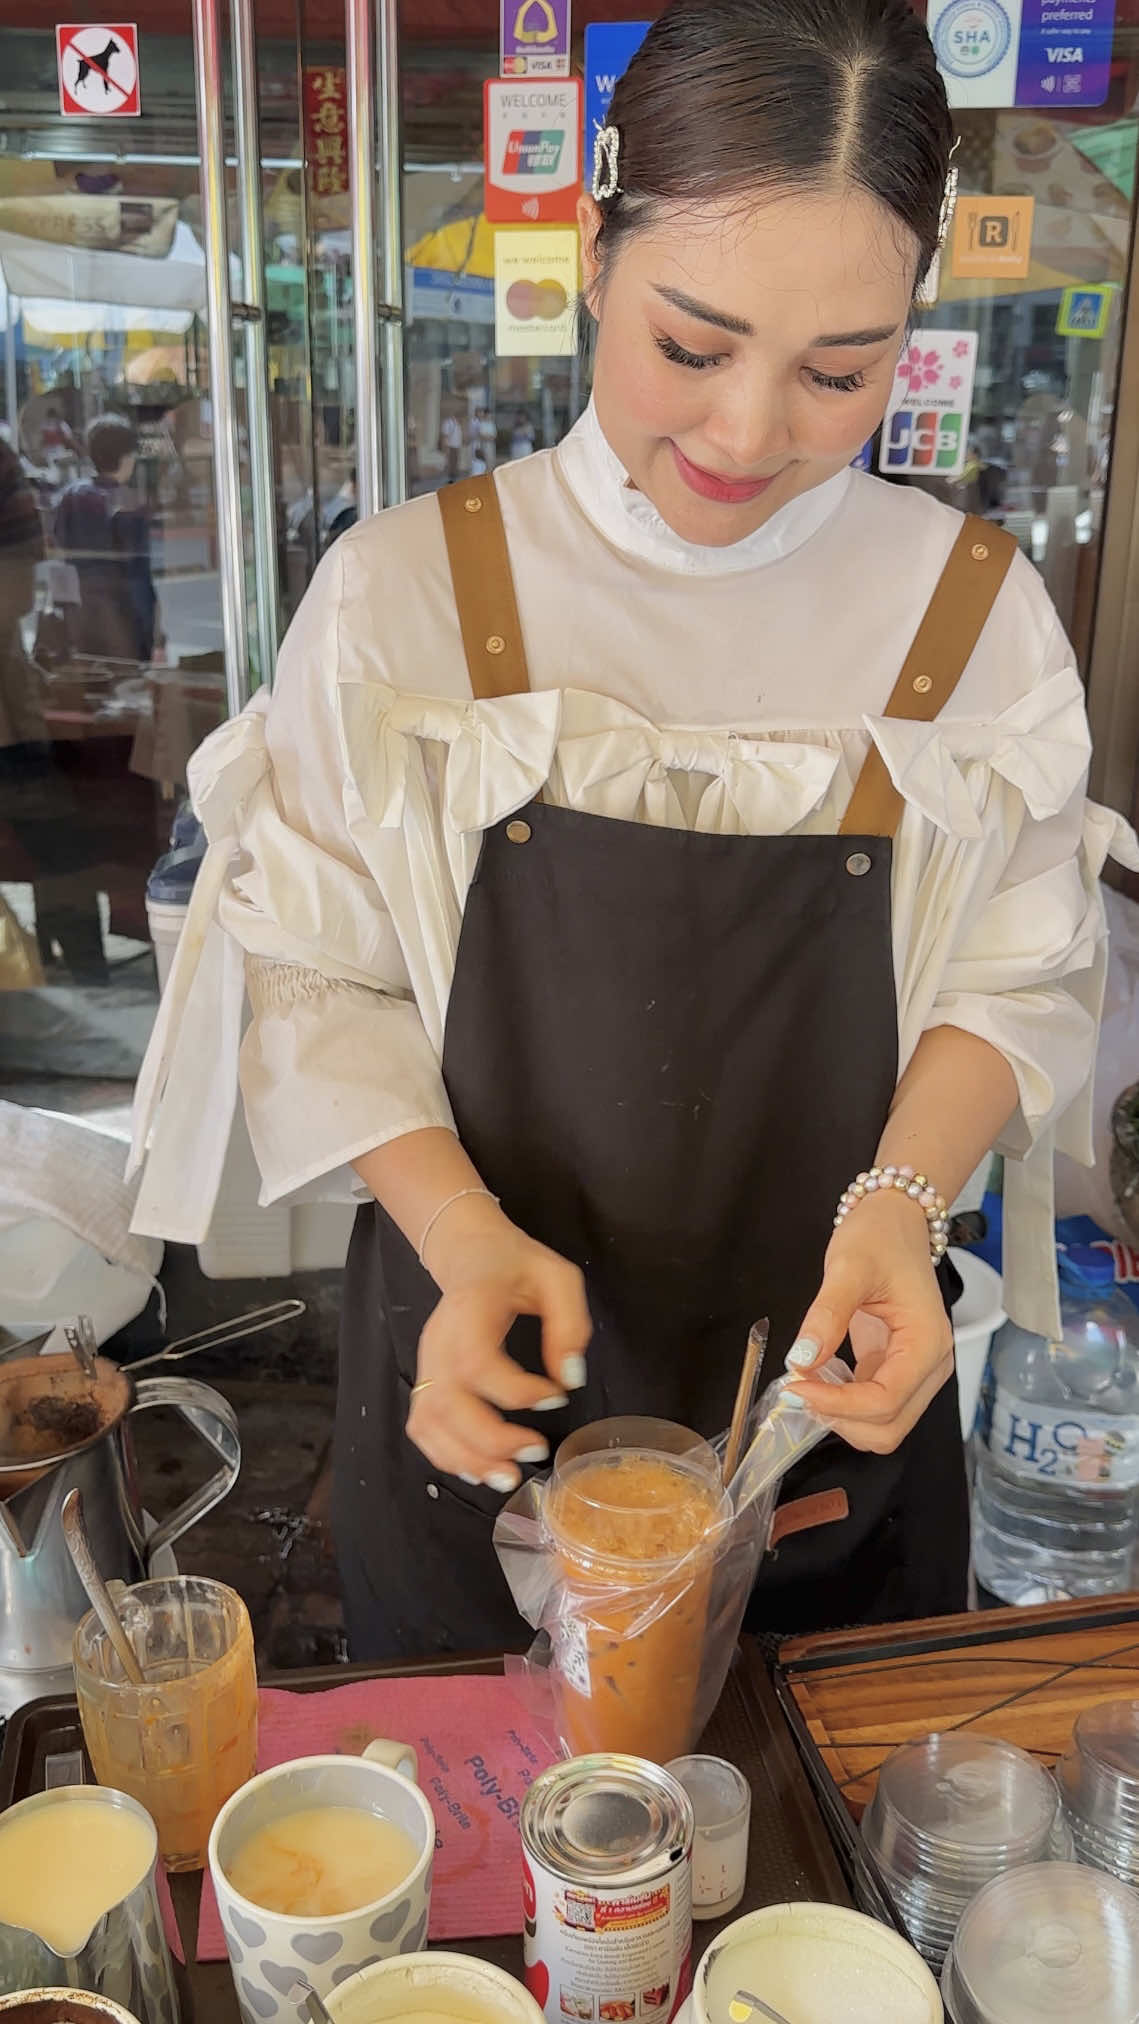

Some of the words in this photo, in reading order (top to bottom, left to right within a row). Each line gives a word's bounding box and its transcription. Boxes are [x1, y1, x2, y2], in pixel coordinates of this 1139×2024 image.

[1040, 9, 1094, 23] preferred
[954, 30, 991, 44] SHA
[1045, 47, 1084, 63] VISA
[500, 93, 568, 109] WELCOME
[985, 221, 1003, 243] R
[464, 1755, 521, 1830] Poly-Br
